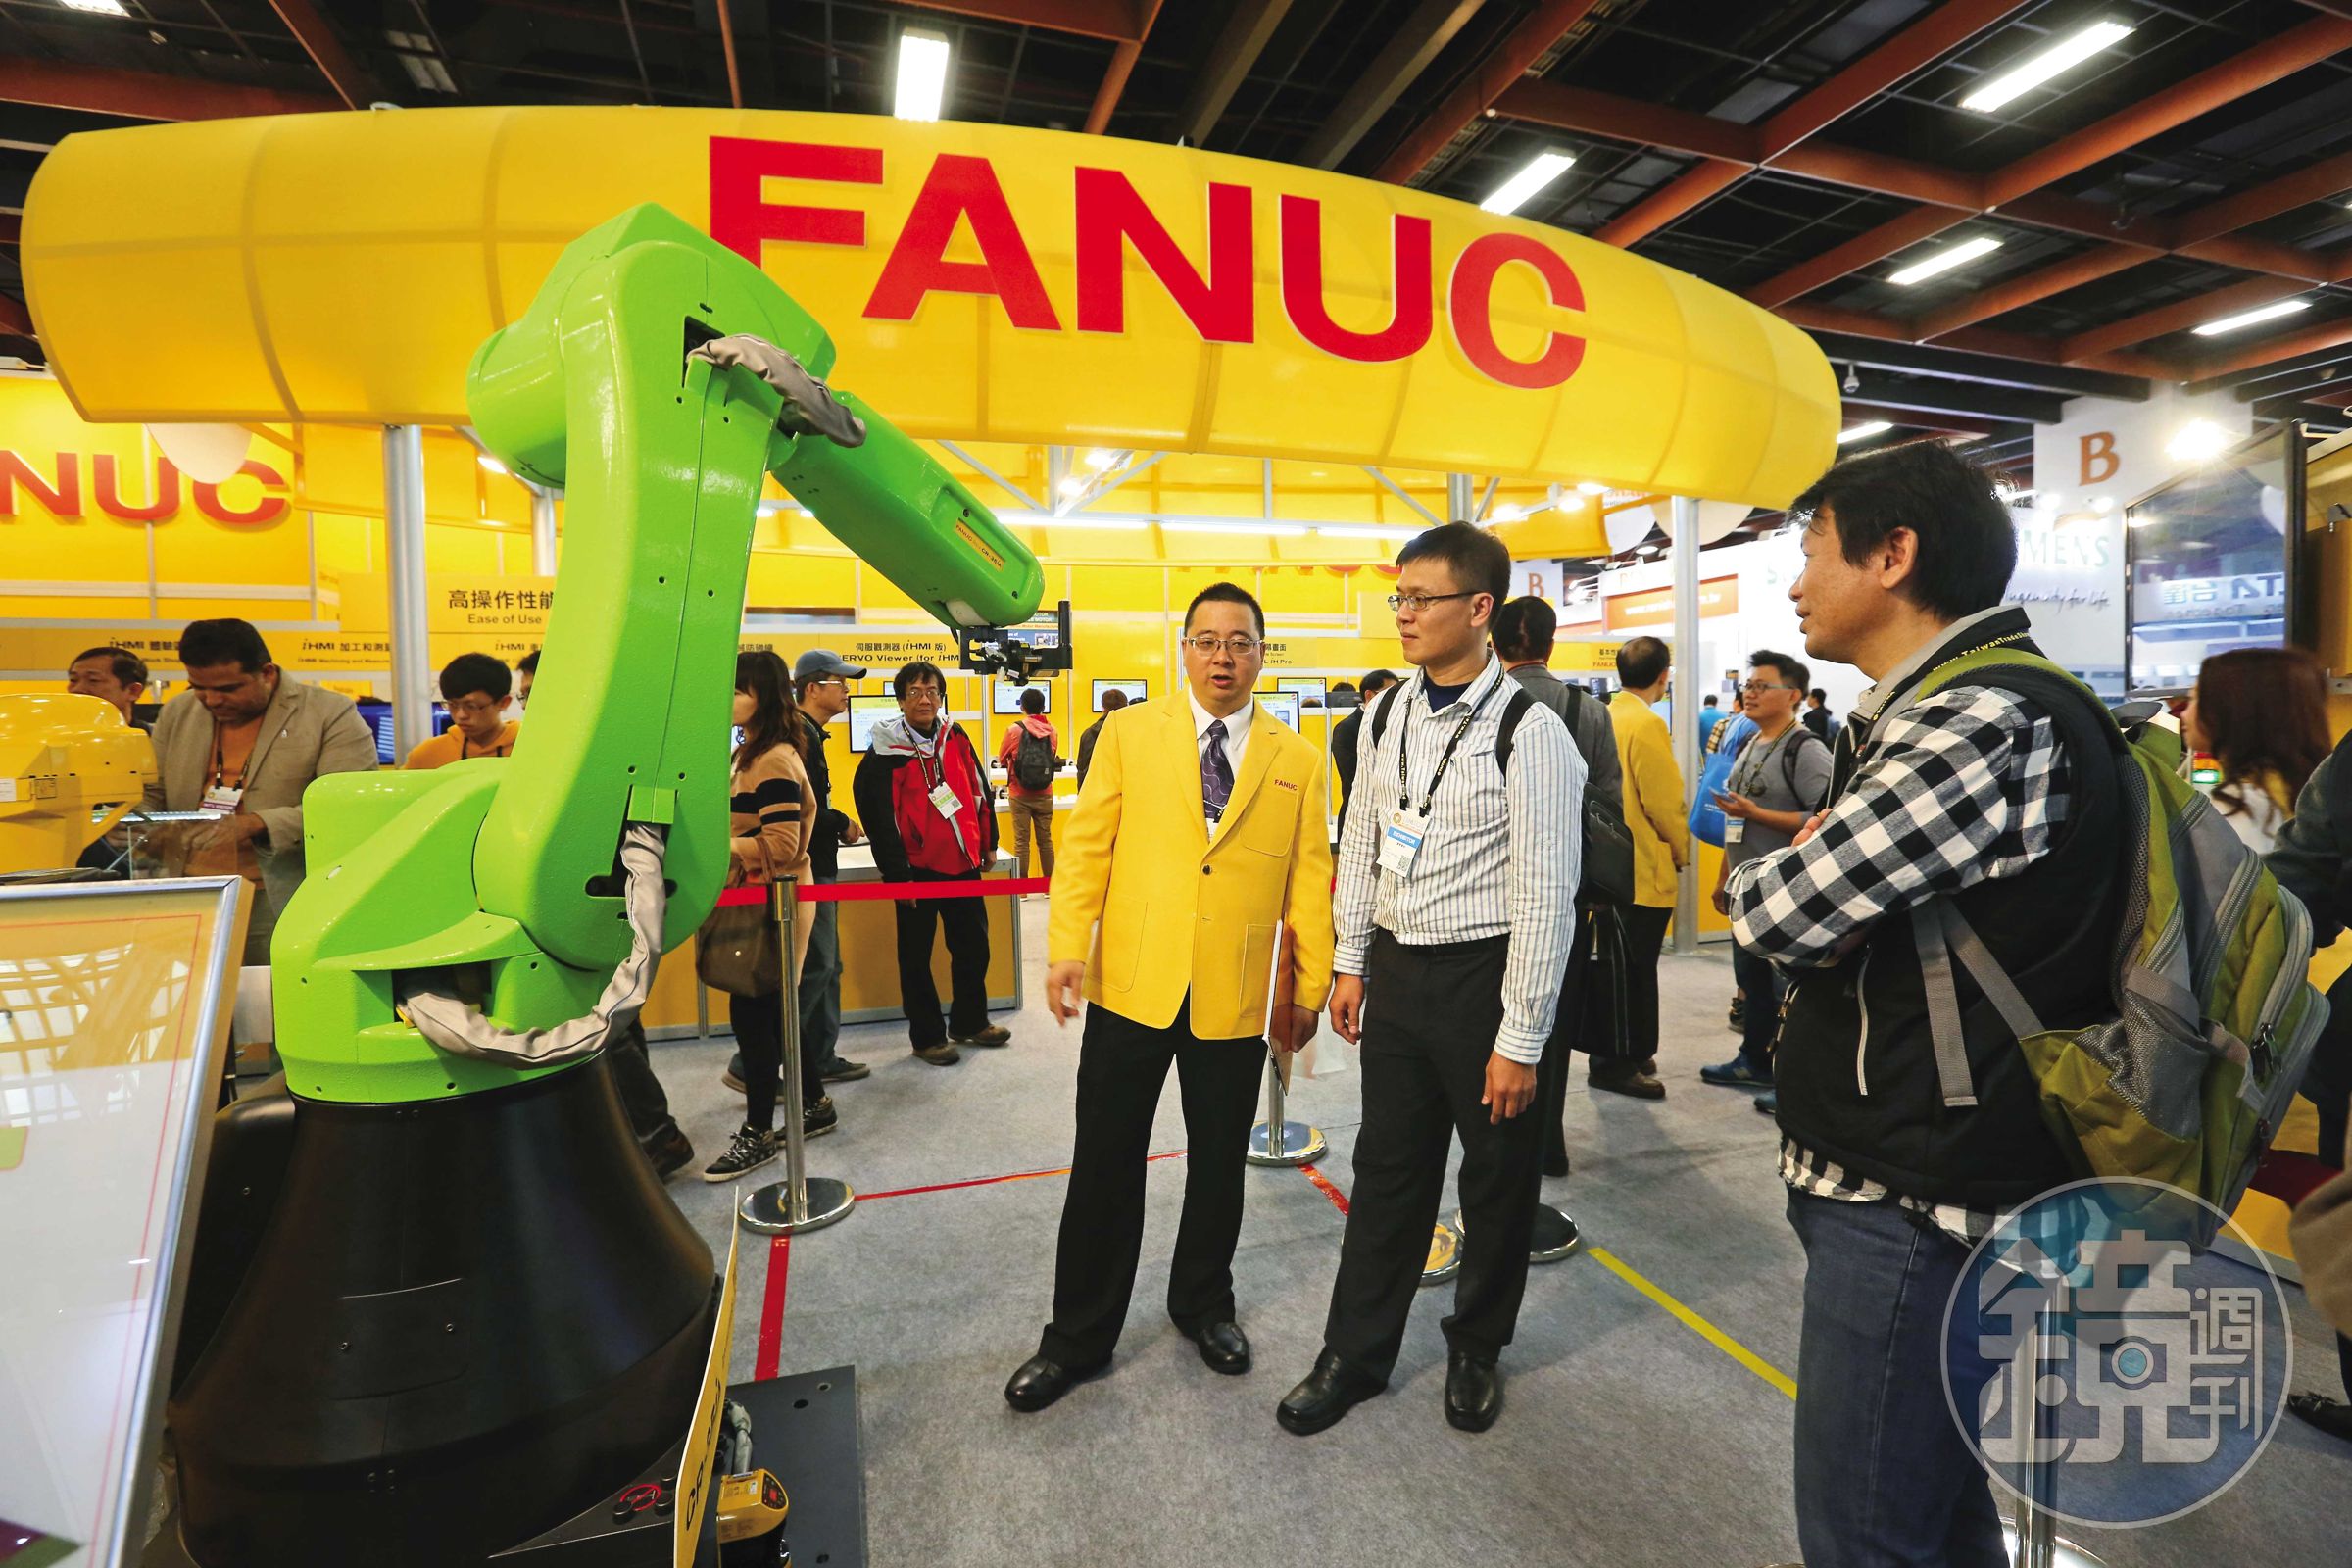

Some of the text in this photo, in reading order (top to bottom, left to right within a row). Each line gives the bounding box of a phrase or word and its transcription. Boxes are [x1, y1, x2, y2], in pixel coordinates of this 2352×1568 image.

[709, 135, 1587, 389] FANUC
[2079, 431, 2121, 486] B
[2021, 529, 2111, 568] MENS
[1528, 572, 1544, 597] B
[468, 614, 541, 624] Ease of Use
[302, 638, 335, 650] iHMI
[916, 654, 934, 663] (for
[938, 651, 959, 661] iHM
[1274, 779, 1298, 791] FANUC
